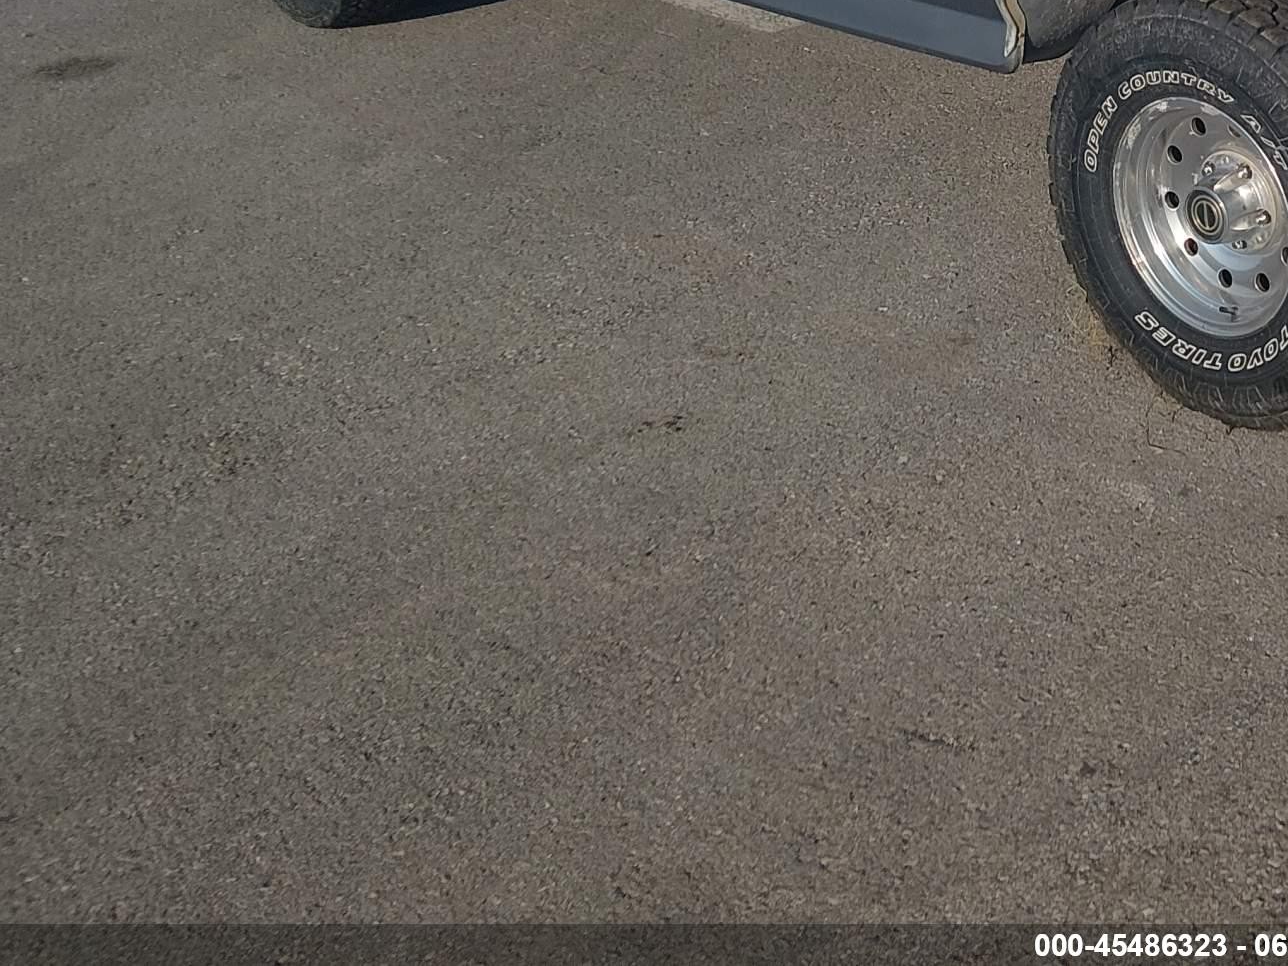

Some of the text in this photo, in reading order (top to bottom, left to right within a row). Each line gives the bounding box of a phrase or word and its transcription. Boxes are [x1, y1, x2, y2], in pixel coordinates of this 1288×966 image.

[1084, 98, 1118, 172] OPEN
[1117, 70, 1236, 105] COUNTRY
[1134, 311, 1223, 371] TIRES
